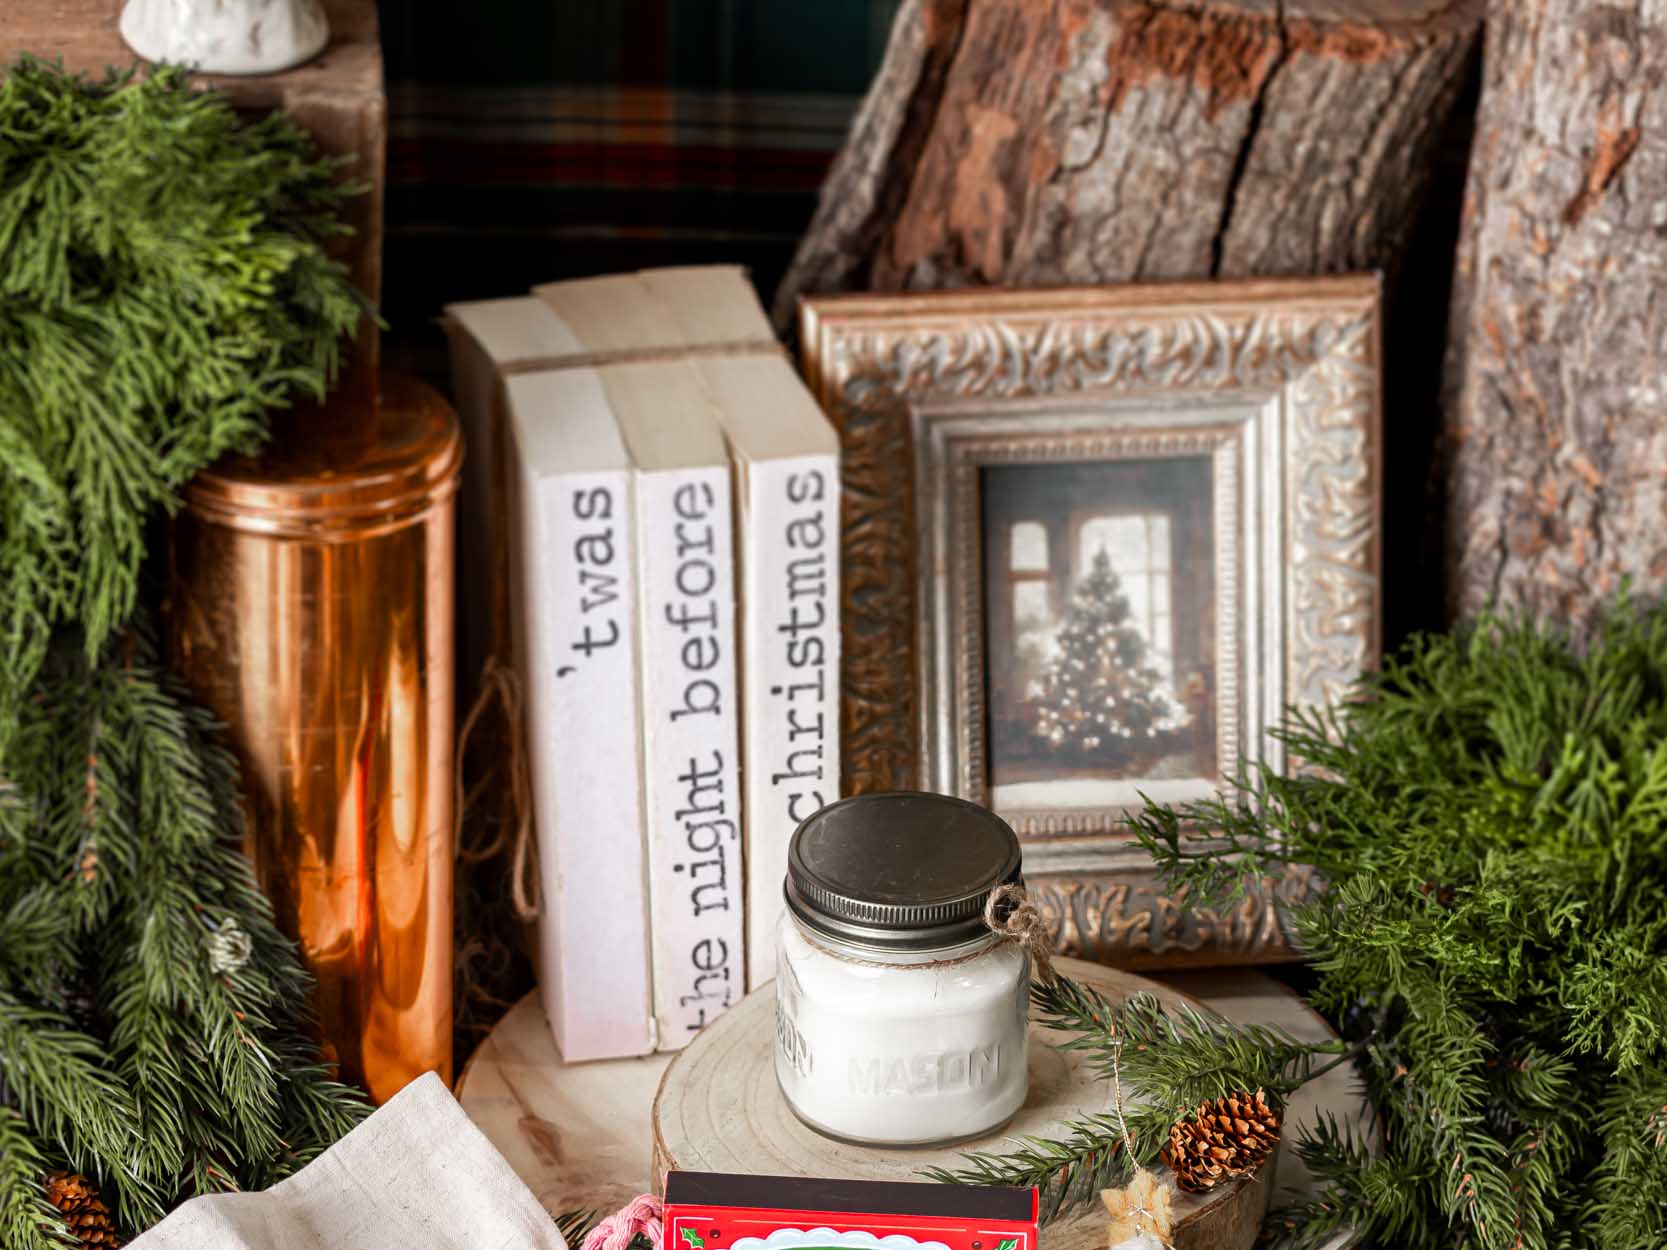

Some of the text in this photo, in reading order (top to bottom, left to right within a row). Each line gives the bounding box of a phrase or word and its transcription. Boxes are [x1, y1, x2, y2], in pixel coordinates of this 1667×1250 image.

[556, 486, 619, 677] 'twas
[772, 469, 826, 825] christmas
[666, 481, 738, 1031] the night before
[849, 1047, 1000, 1096] MASON
